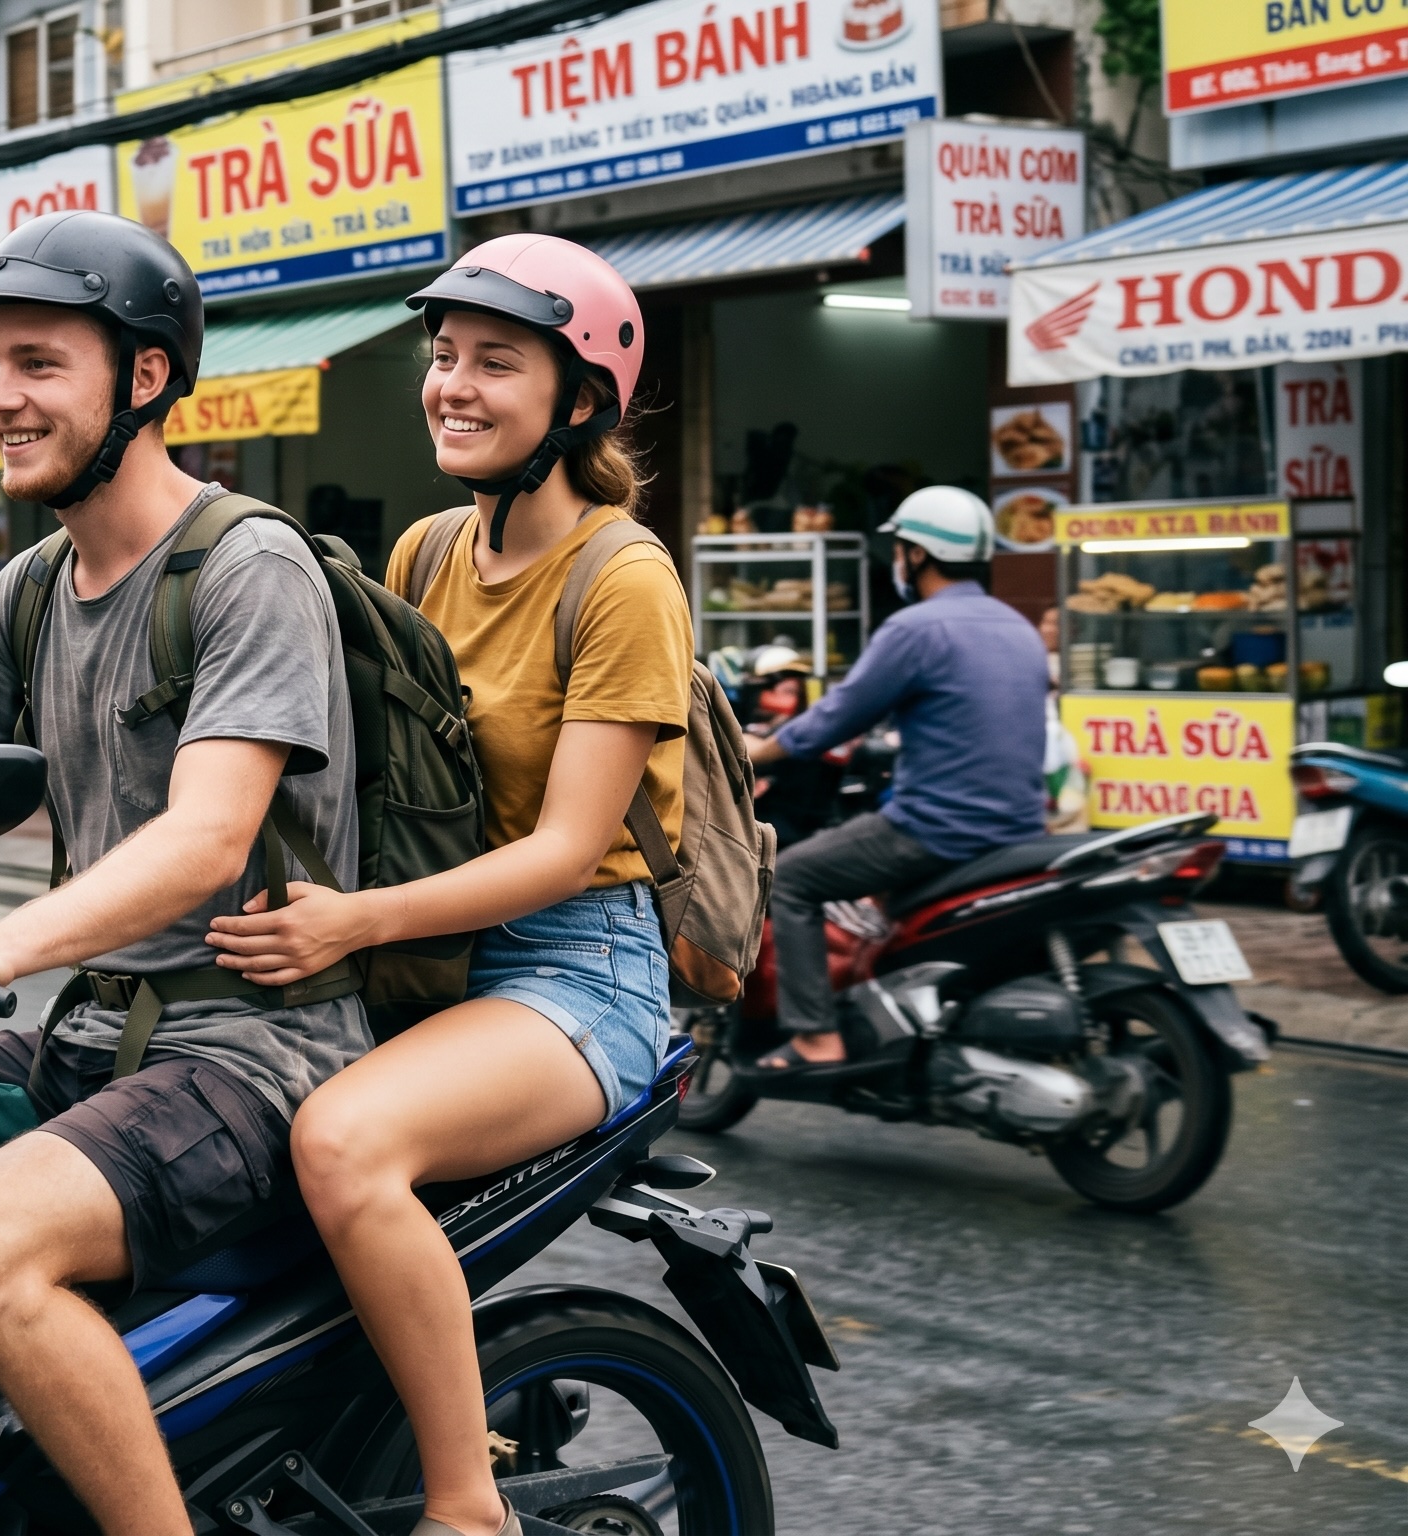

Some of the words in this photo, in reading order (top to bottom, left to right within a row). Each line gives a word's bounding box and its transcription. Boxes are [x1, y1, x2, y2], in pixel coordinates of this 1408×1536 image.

[512, 37, 633, 121] TIỆM
[655, 1, 809, 90] BÁNH
[189, 118, 289, 220] TRÀ
[308, 96, 423, 197] SỮA
[952, 191, 1002, 235] TRÀ
[1013, 195, 1065, 240] SỮA
[1115, 249, 1408, 331] HOND
[1283, 362, 1354, 427] TRÀ
[1085, 709, 1168, 755] TRÀ
[1182, 711, 1271, 760] SỮA
